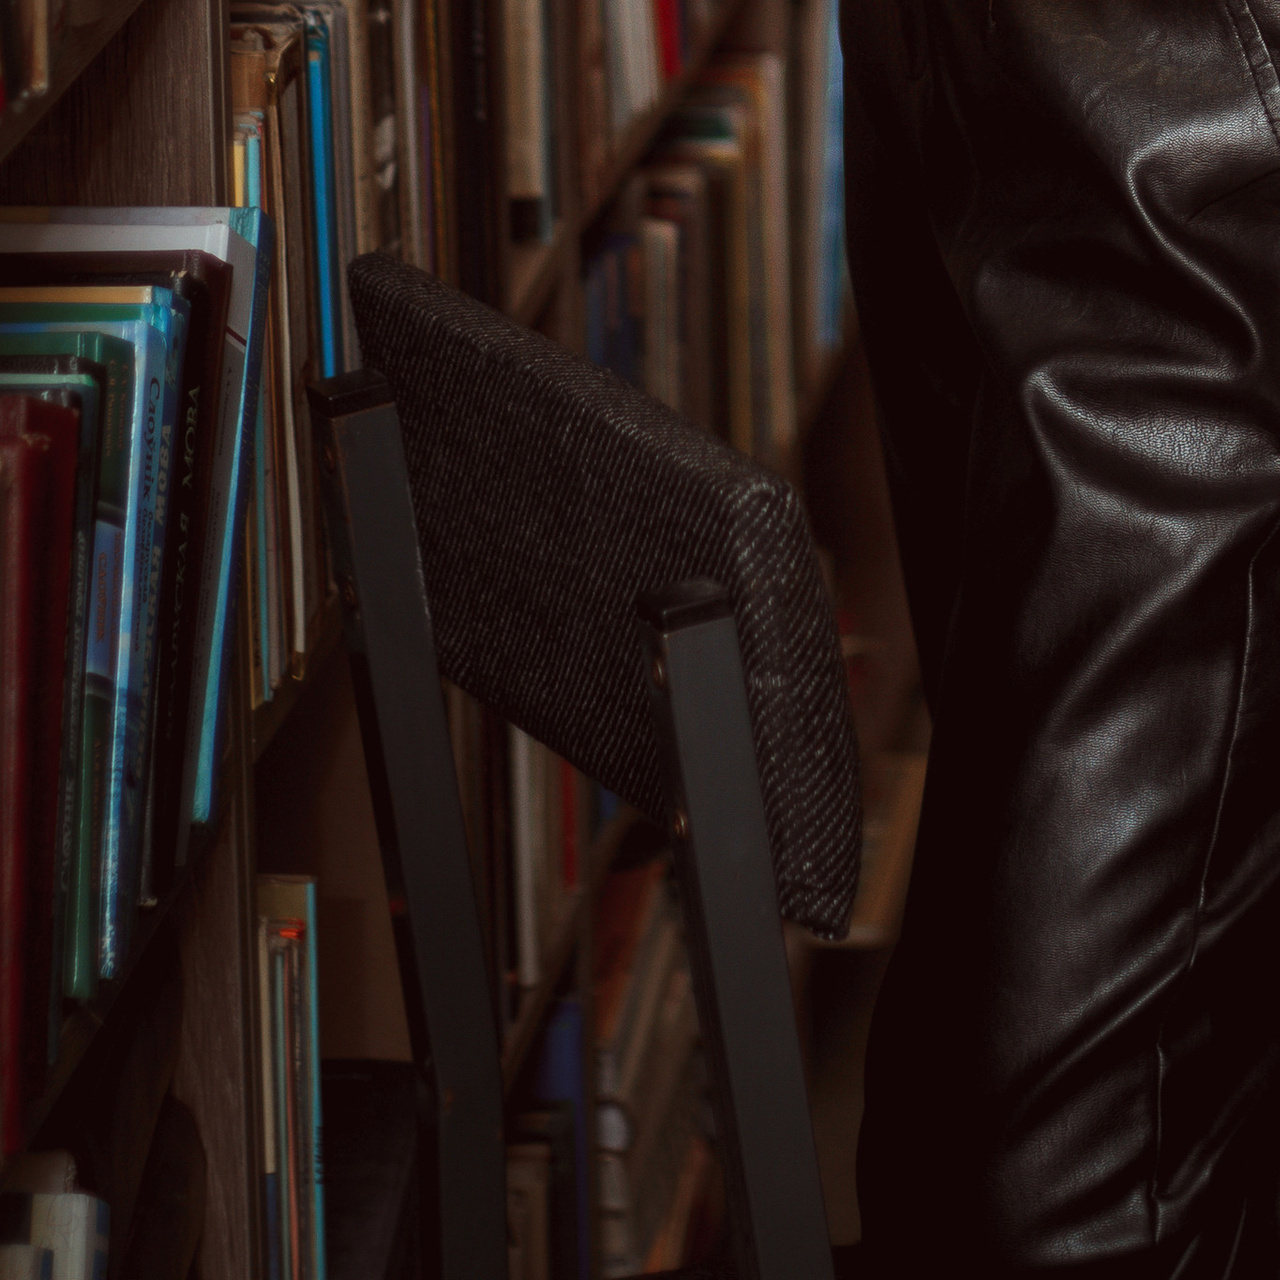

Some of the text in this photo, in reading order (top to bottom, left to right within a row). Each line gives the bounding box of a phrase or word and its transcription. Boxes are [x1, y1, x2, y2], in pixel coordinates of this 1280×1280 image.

[143, 376, 160, 502] Слоўнік
[181, 385, 200, 488] МОВА
[136, 423, 171, 780] БЕЛАРУСКАЯ МОВА
